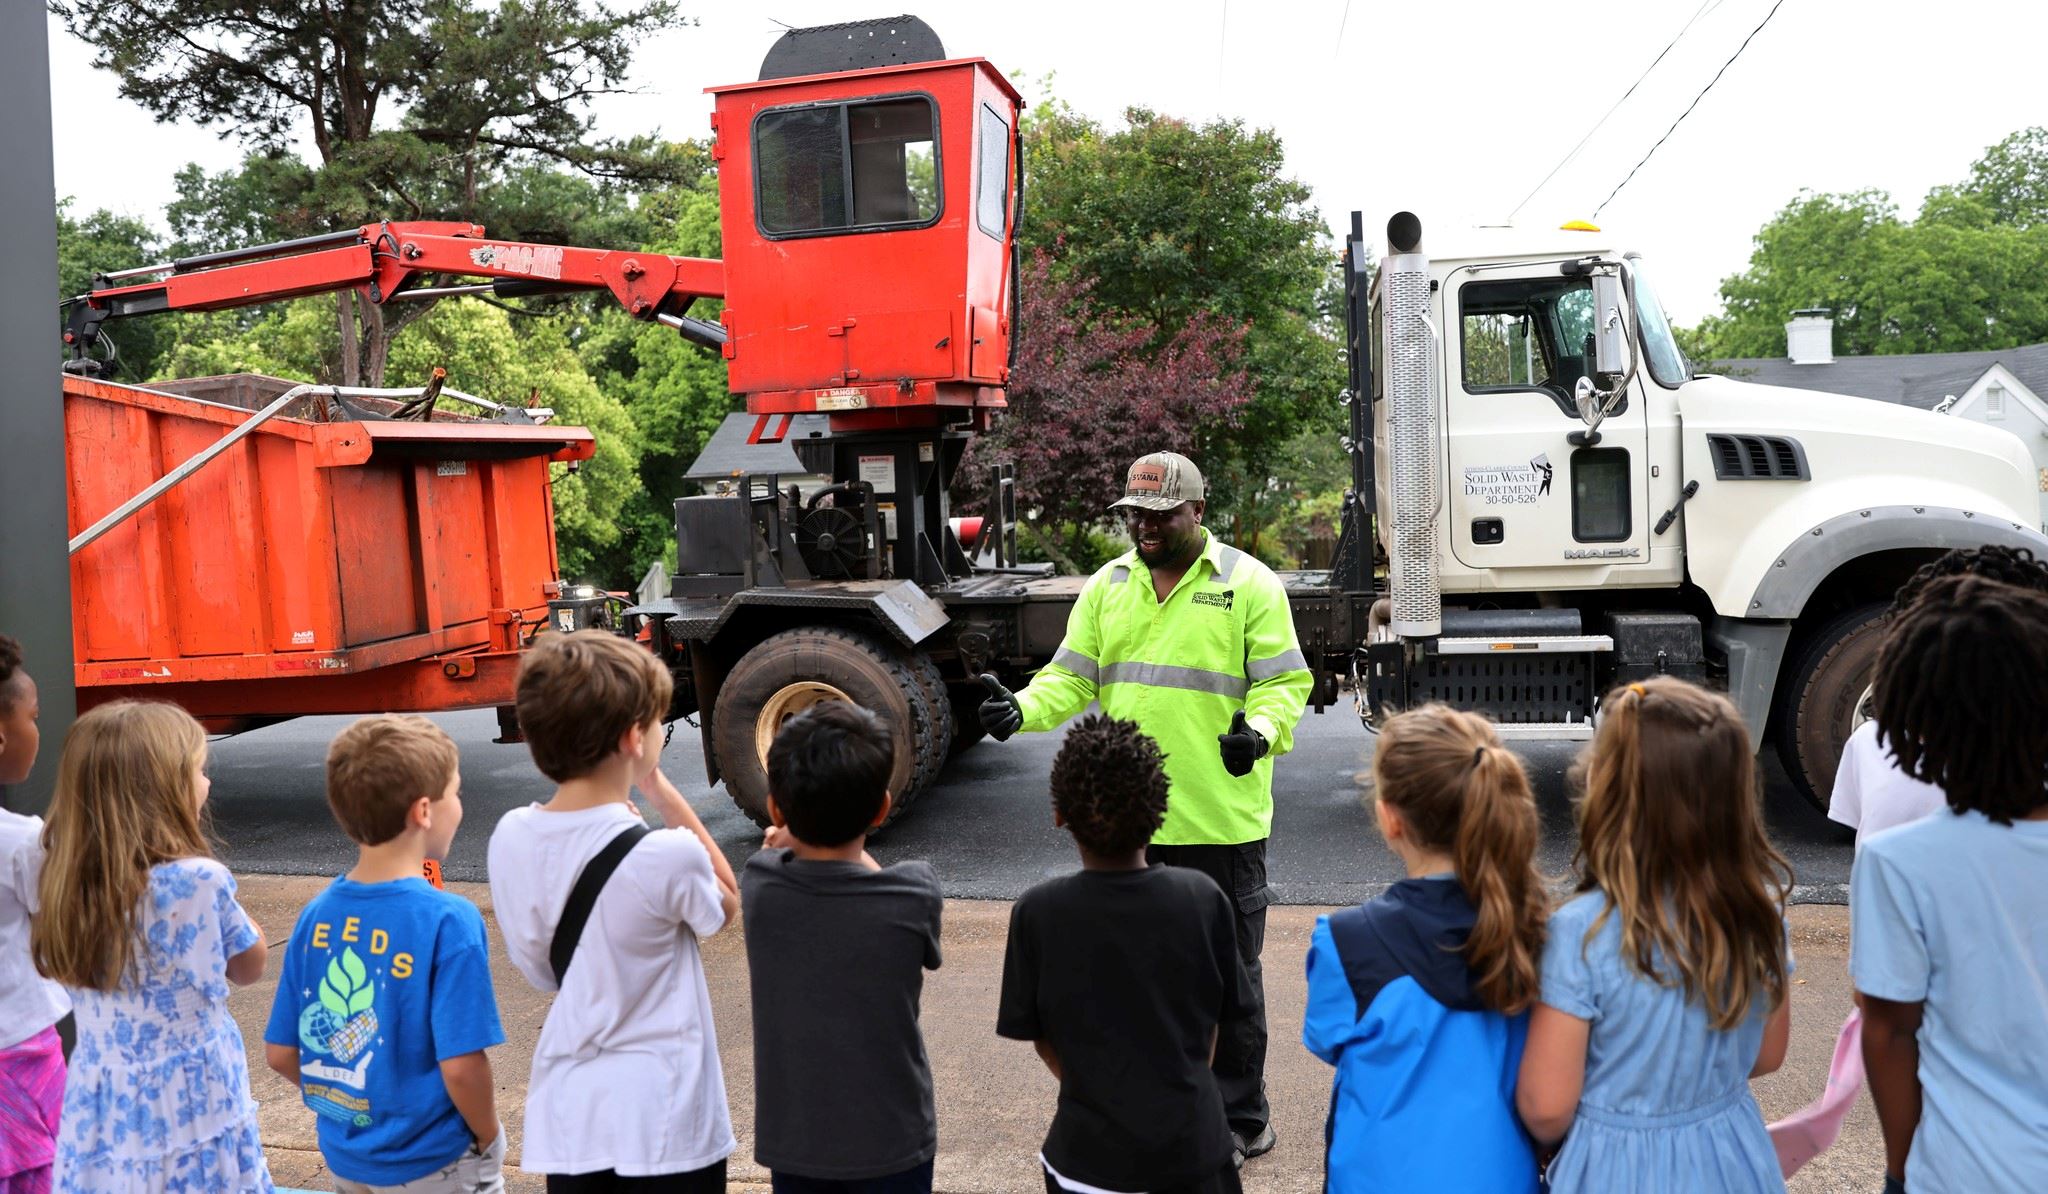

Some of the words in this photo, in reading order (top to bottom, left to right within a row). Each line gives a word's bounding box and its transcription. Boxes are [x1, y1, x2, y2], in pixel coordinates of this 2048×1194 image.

[1464, 473, 1498, 484] SOLID
[1501, 471, 1538, 483] WASTE
[1465, 484, 1539, 496] DEPARTMENT
[1485, 494, 1537, 505] 30-50-526
[1564, 547, 1641, 560] MACK
[1191, 598, 1226, 608] DEPARTMENT
